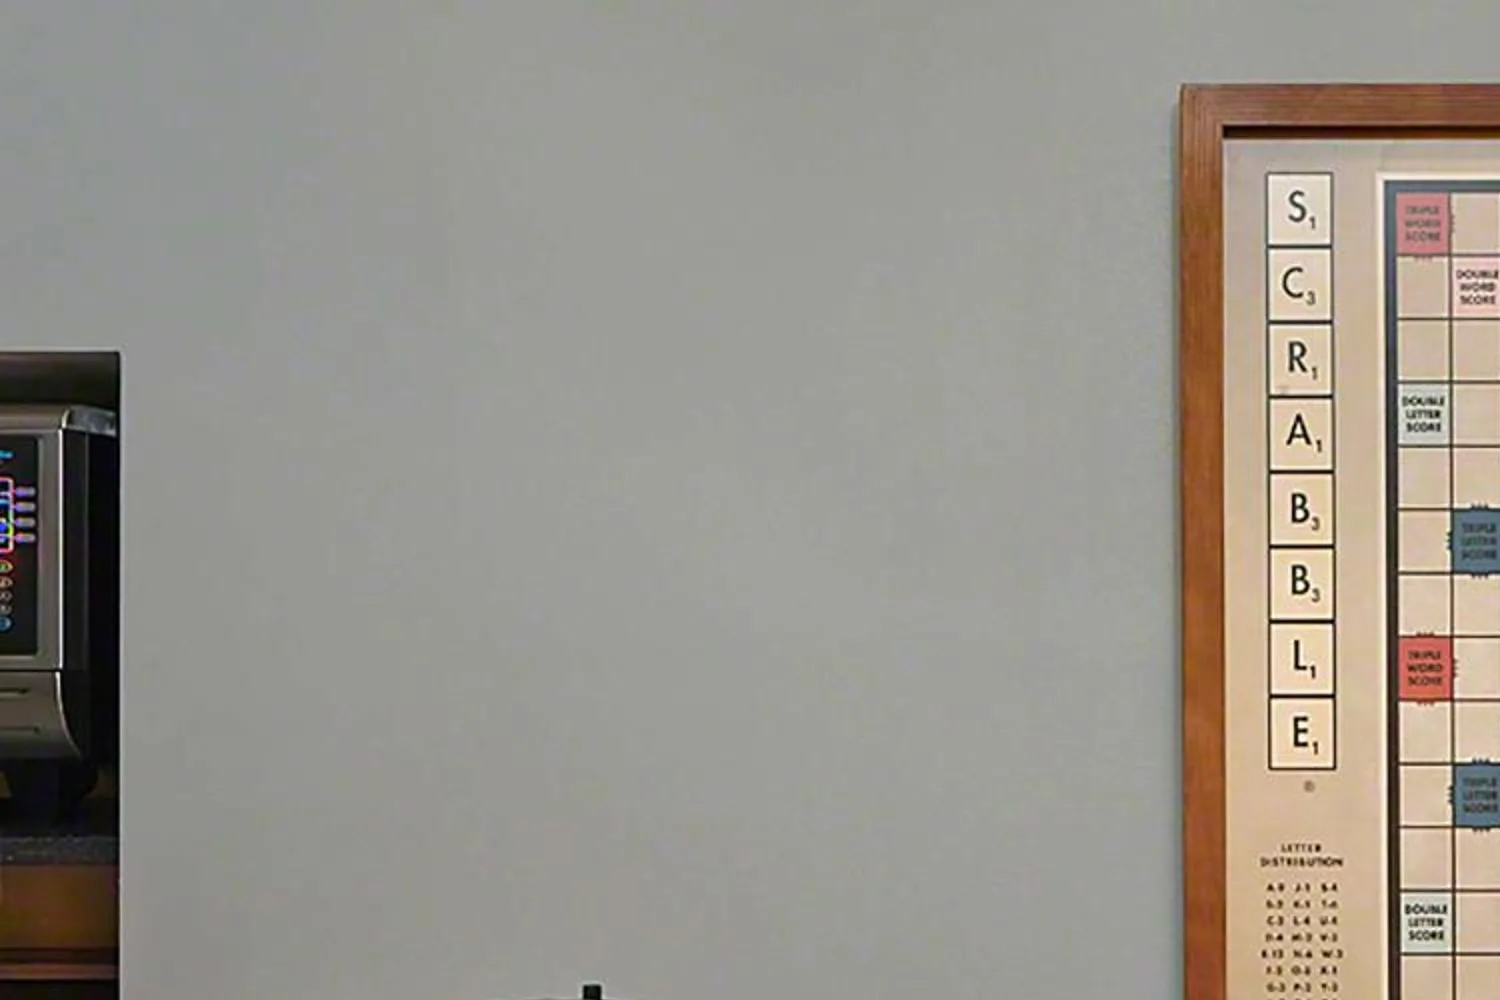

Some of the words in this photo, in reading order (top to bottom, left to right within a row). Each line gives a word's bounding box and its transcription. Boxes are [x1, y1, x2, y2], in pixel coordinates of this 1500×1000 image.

[1456, 269, 1500, 280] DOUBLE
[1459, 281, 1497, 293] WORD
[1459, 294, 1497, 306] SCORE
[1402, 395, 1445, 407] DOUBLE
[1405, 409, 1442, 420] LETTER
[1405, 421, 1442, 433] SCORE
[1404, 903, 1448, 915] DOUBLE
[1407, 917, 1444, 928] LETTER
[1408, 929, 1445, 941] SCORE
